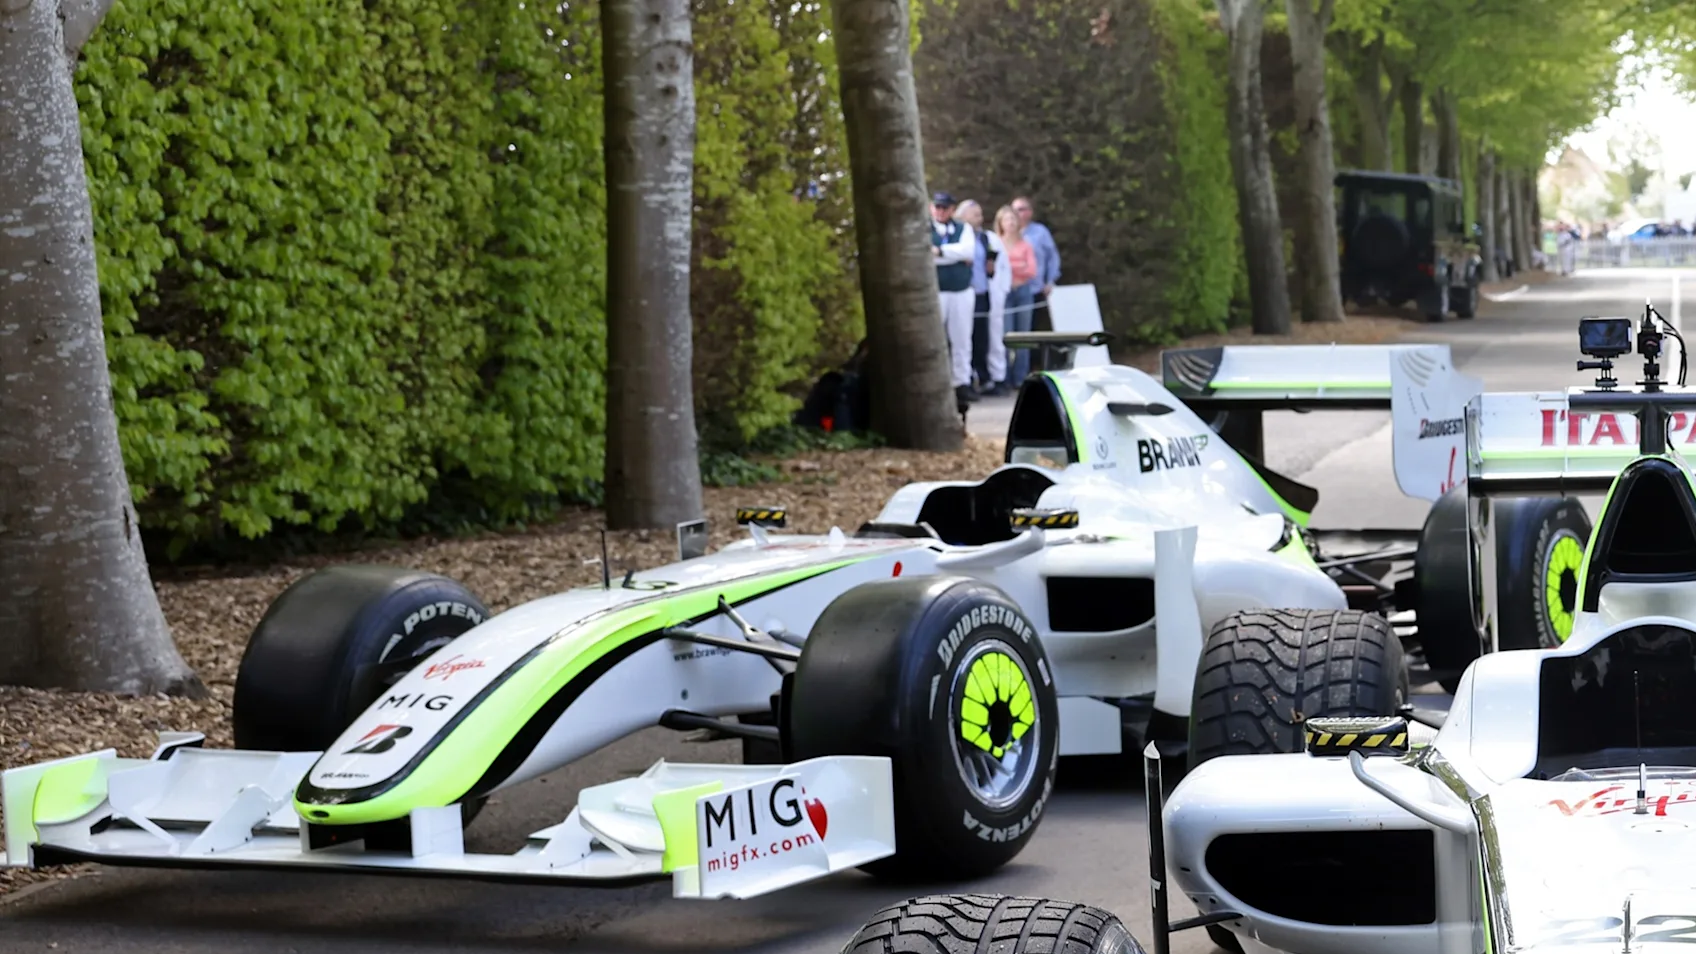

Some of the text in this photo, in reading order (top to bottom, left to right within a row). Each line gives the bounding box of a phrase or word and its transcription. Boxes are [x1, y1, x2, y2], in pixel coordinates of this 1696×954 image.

[1419, 418, 1465, 440] BRIDGEST
[403, 601, 487, 635] POTEN
[937, 604, 1032, 670] BRIDGESTONE
[377, 693, 454, 711] MIG
[704, 778, 804, 848] MIG
[708, 833, 815, 872] migfx.com
